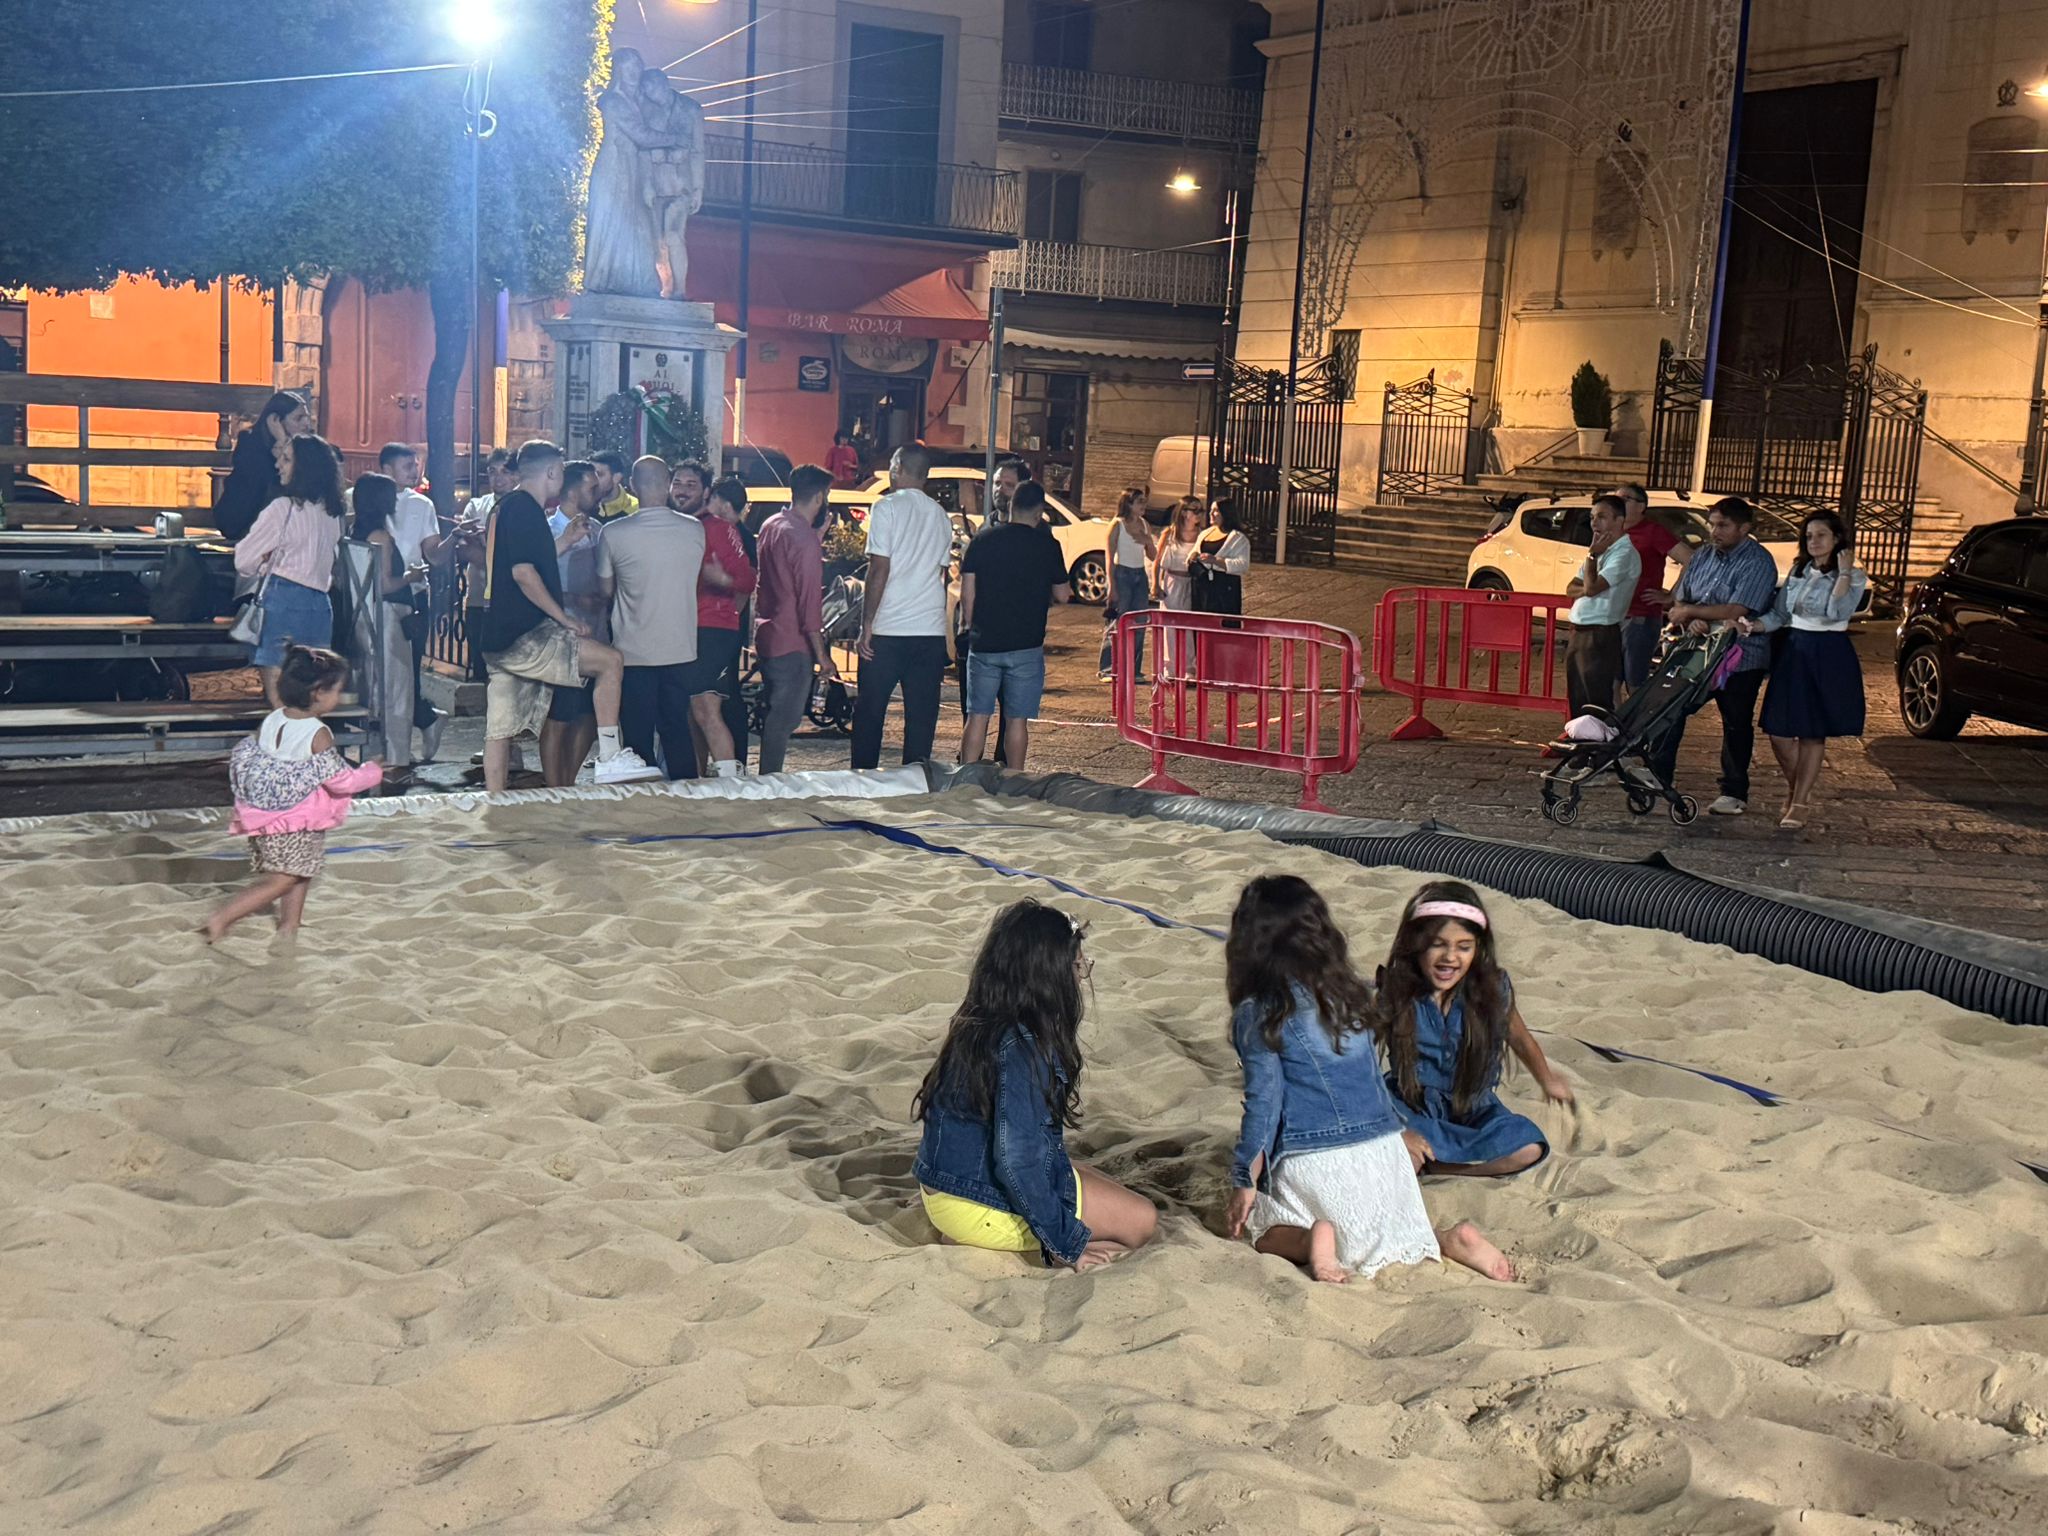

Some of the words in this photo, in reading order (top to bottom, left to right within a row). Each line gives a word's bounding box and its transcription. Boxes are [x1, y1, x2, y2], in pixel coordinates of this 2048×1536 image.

[788, 312, 832, 332] BAR
[846, 316, 904, 335] ROMA
[860, 345, 915, 361] ROMA
